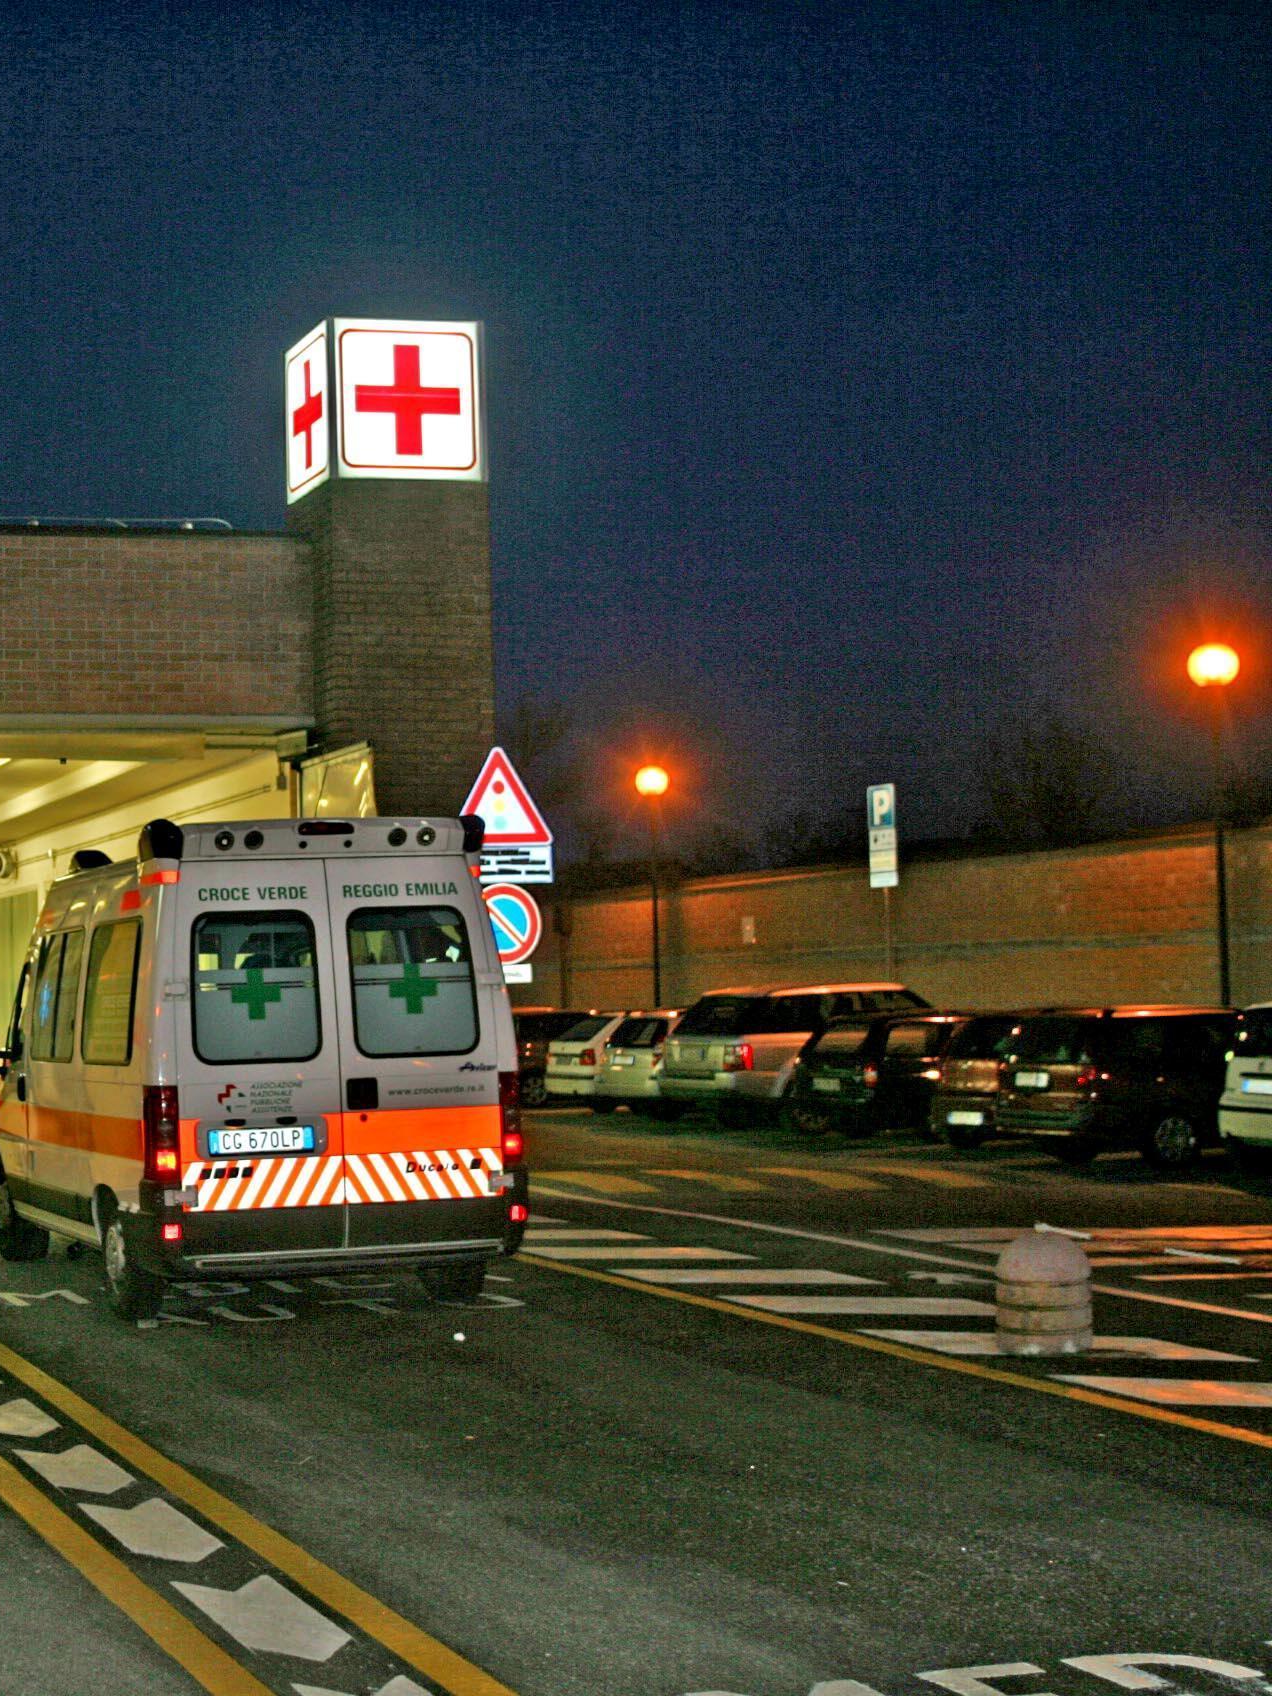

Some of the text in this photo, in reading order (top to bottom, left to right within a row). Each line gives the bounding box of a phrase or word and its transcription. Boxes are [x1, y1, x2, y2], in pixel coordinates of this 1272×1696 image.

[873, 789, 891, 826] P
[198, 886, 308, 902] CROCE VERDE
[342, 881, 459, 898] REGGIO EMILIA
[222, 1130, 301, 1150] CG 670LP
